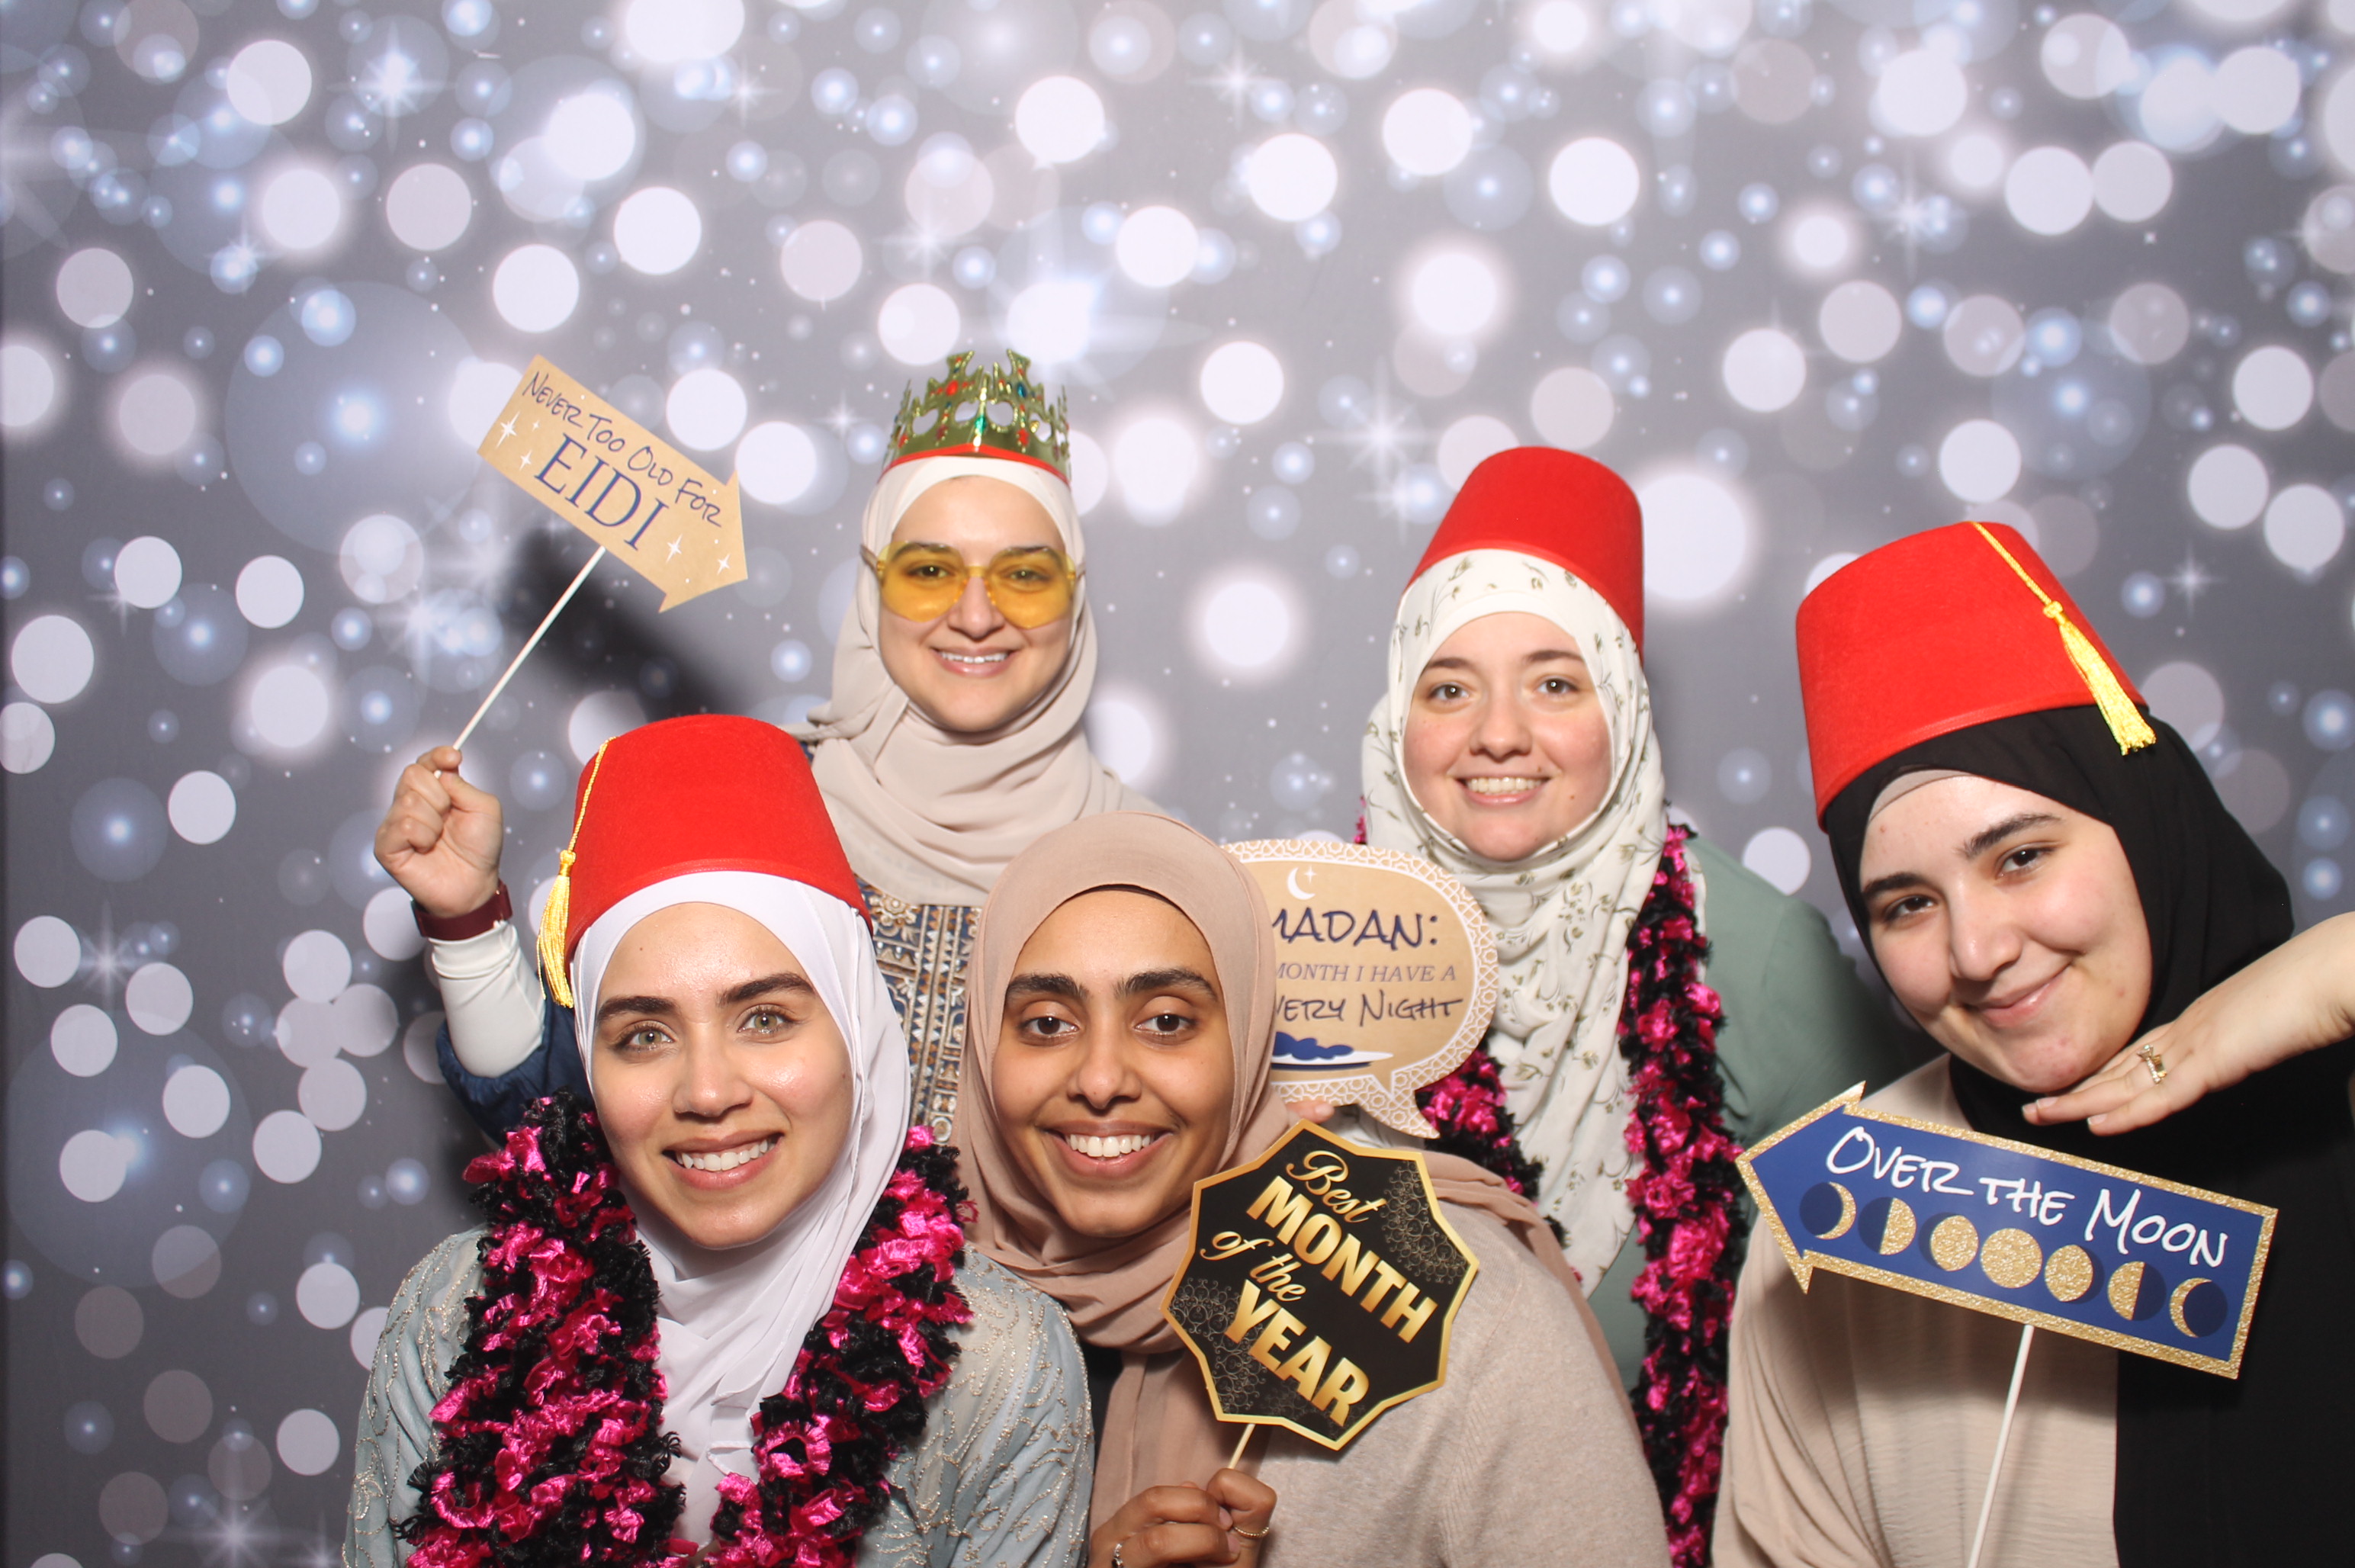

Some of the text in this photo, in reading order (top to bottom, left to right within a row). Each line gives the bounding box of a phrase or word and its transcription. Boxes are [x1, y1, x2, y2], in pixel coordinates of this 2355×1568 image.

[522, 371, 721, 528] NEVER TOO OLD FOR
[534, 432, 670, 551] EIDI
[1354, 965, 1367, 983] I
[1371, 965, 1437, 983] HAVE
[1440, 966, 1457, 982] A
[1358, 989, 1463, 1027] NIGHT
[1286, 1150, 1387, 1223] Best
[1826, 1126, 2228, 1268] OVER THE MOON
[1200, 1231, 1306, 1302] of the
[1246, 1175, 1438, 1344] MONTH
[1224, 1279, 1370, 1428] YEAR
